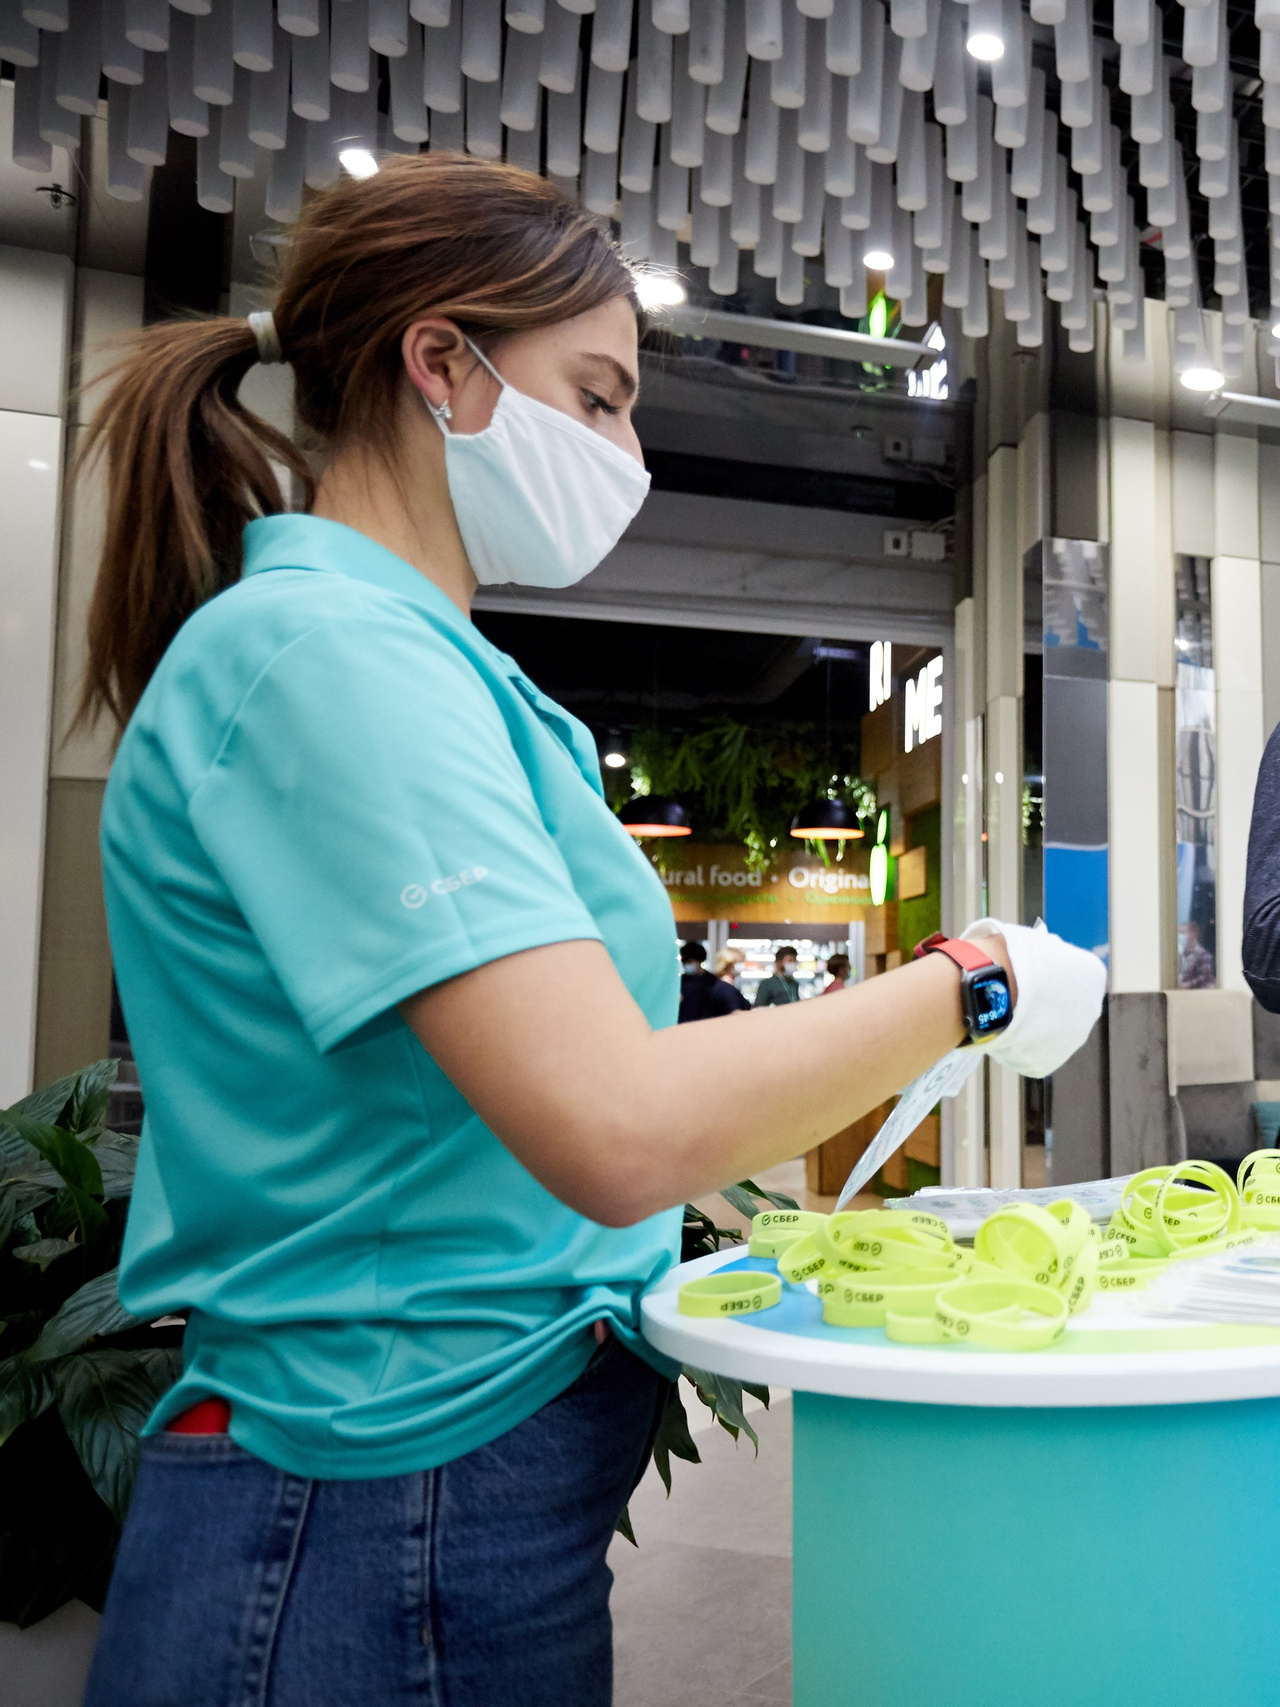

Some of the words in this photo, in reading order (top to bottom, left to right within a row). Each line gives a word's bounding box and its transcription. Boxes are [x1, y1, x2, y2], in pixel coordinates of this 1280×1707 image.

[905, 655, 943, 753] ME
[431, 866, 488, 895] СБЕР
[709, 865, 762, 887] food
[772, 1215, 799, 1223] СБЕР
[912, 1215, 937, 1227] СБЕР
[801, 1258, 826, 1277] СБЕР
[1110, 1277, 1136, 1287] СБЕР
[854, 1293, 884, 1304] СБЕР
[1068, 1276, 1085, 1306] СБЕР
[720, 1299, 750, 1312] СБЕР
